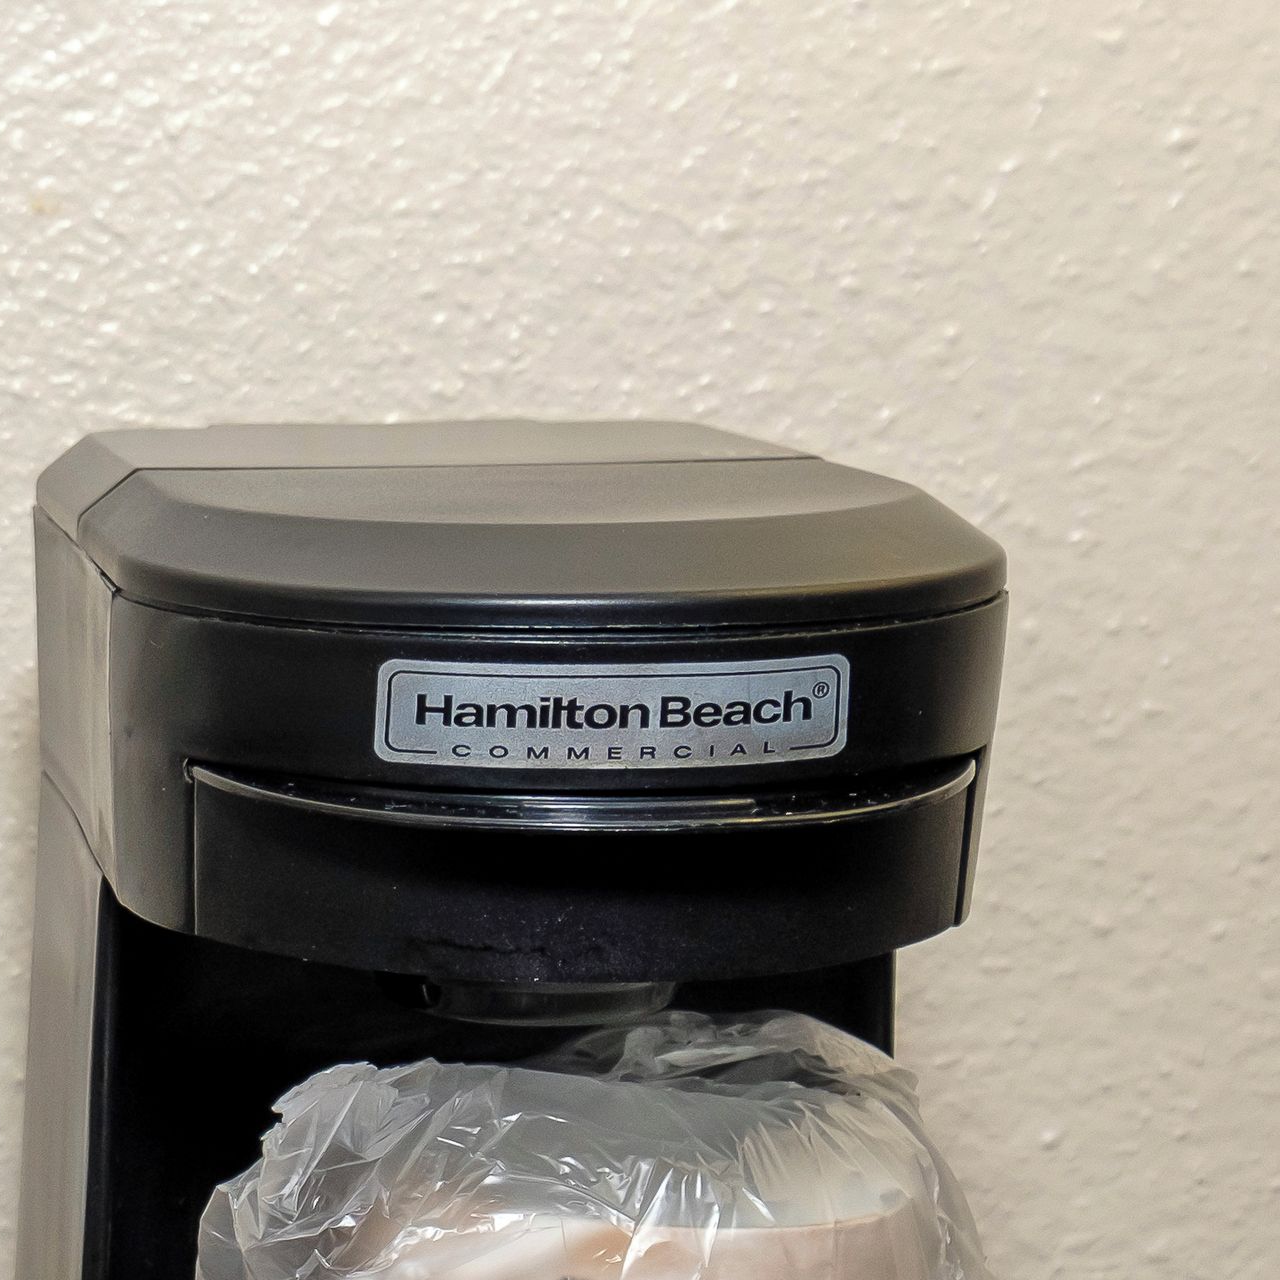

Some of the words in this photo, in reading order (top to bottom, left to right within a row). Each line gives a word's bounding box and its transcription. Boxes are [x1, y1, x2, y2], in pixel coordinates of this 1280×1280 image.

[415, 692, 650, 730] Hamilton
[659, 690, 813, 730] Beach
[451, 740, 776, 761] COMMERCIAL
